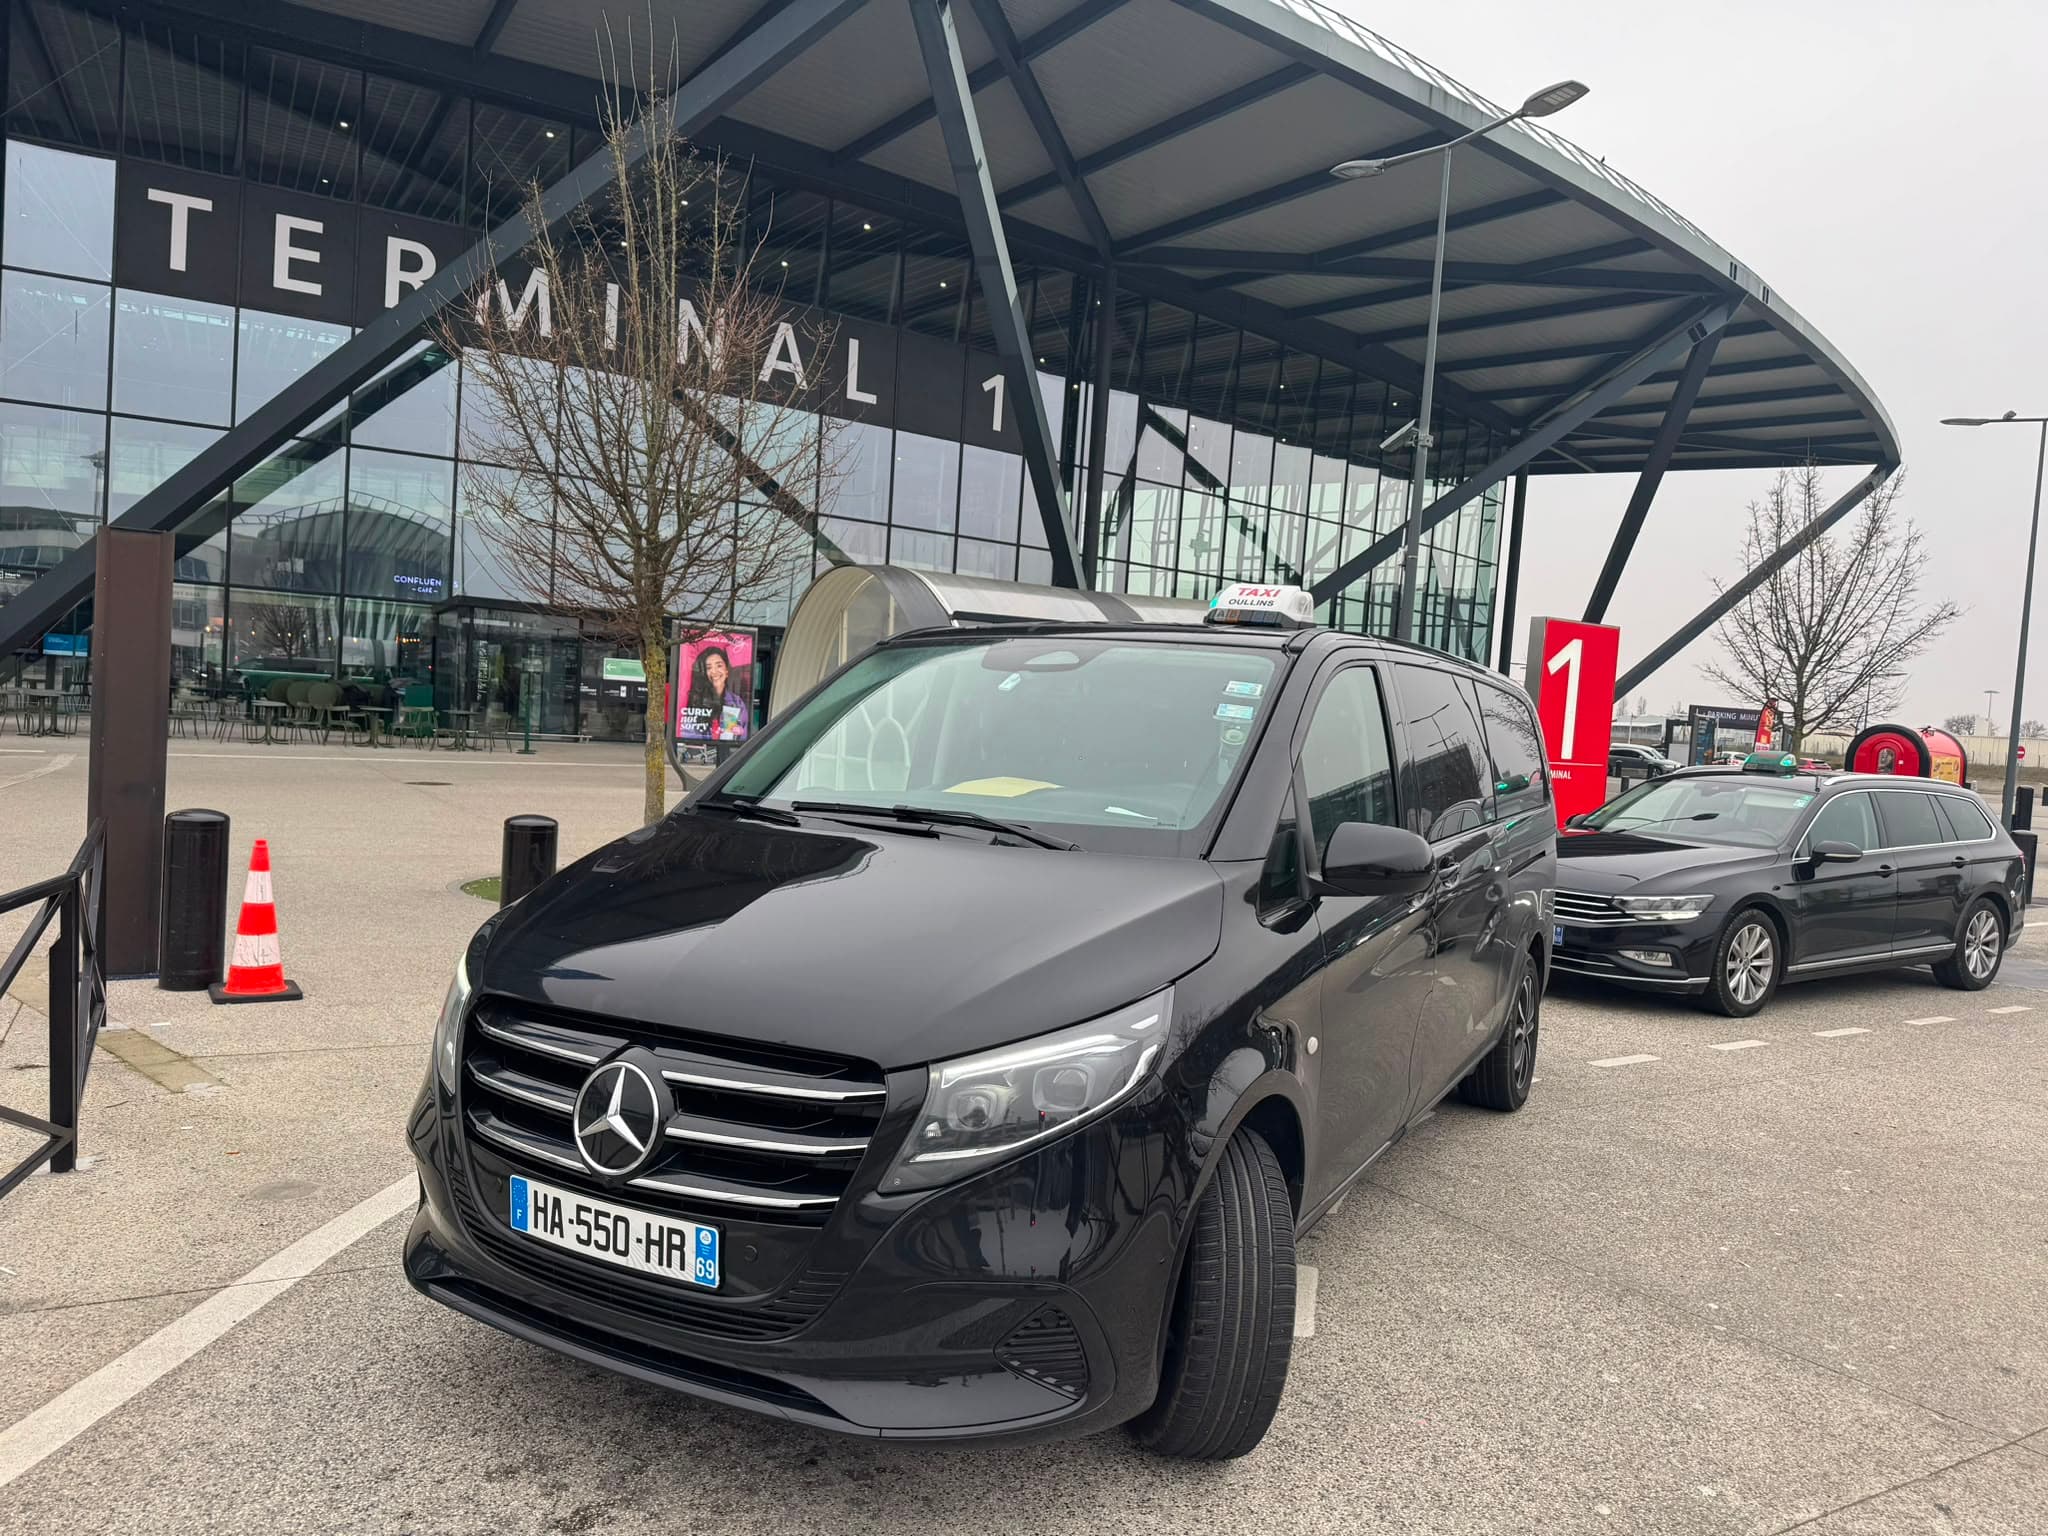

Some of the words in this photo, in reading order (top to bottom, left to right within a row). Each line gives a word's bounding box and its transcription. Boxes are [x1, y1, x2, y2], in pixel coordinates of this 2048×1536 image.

[147, 188, 878, 405] TERMINAL
[981, 374, 1005, 432] 1
[1238, 587, 1281, 598] TAXI
[1228, 598, 1275, 607] OULLINS
[1547, 638, 1583, 760] 1
[680, 707, 713, 717] CURLY
[1707, 711, 1737, 720] PARKING
[1739, 713, 1760, 722] MINU
[680, 715, 698, 723] not
[680, 722, 709, 733] sorry
[516, 1209, 522, 1220] F
[533, 1190, 686, 1271] HA-550-HR
[696, 1257, 714, 1279] 69
